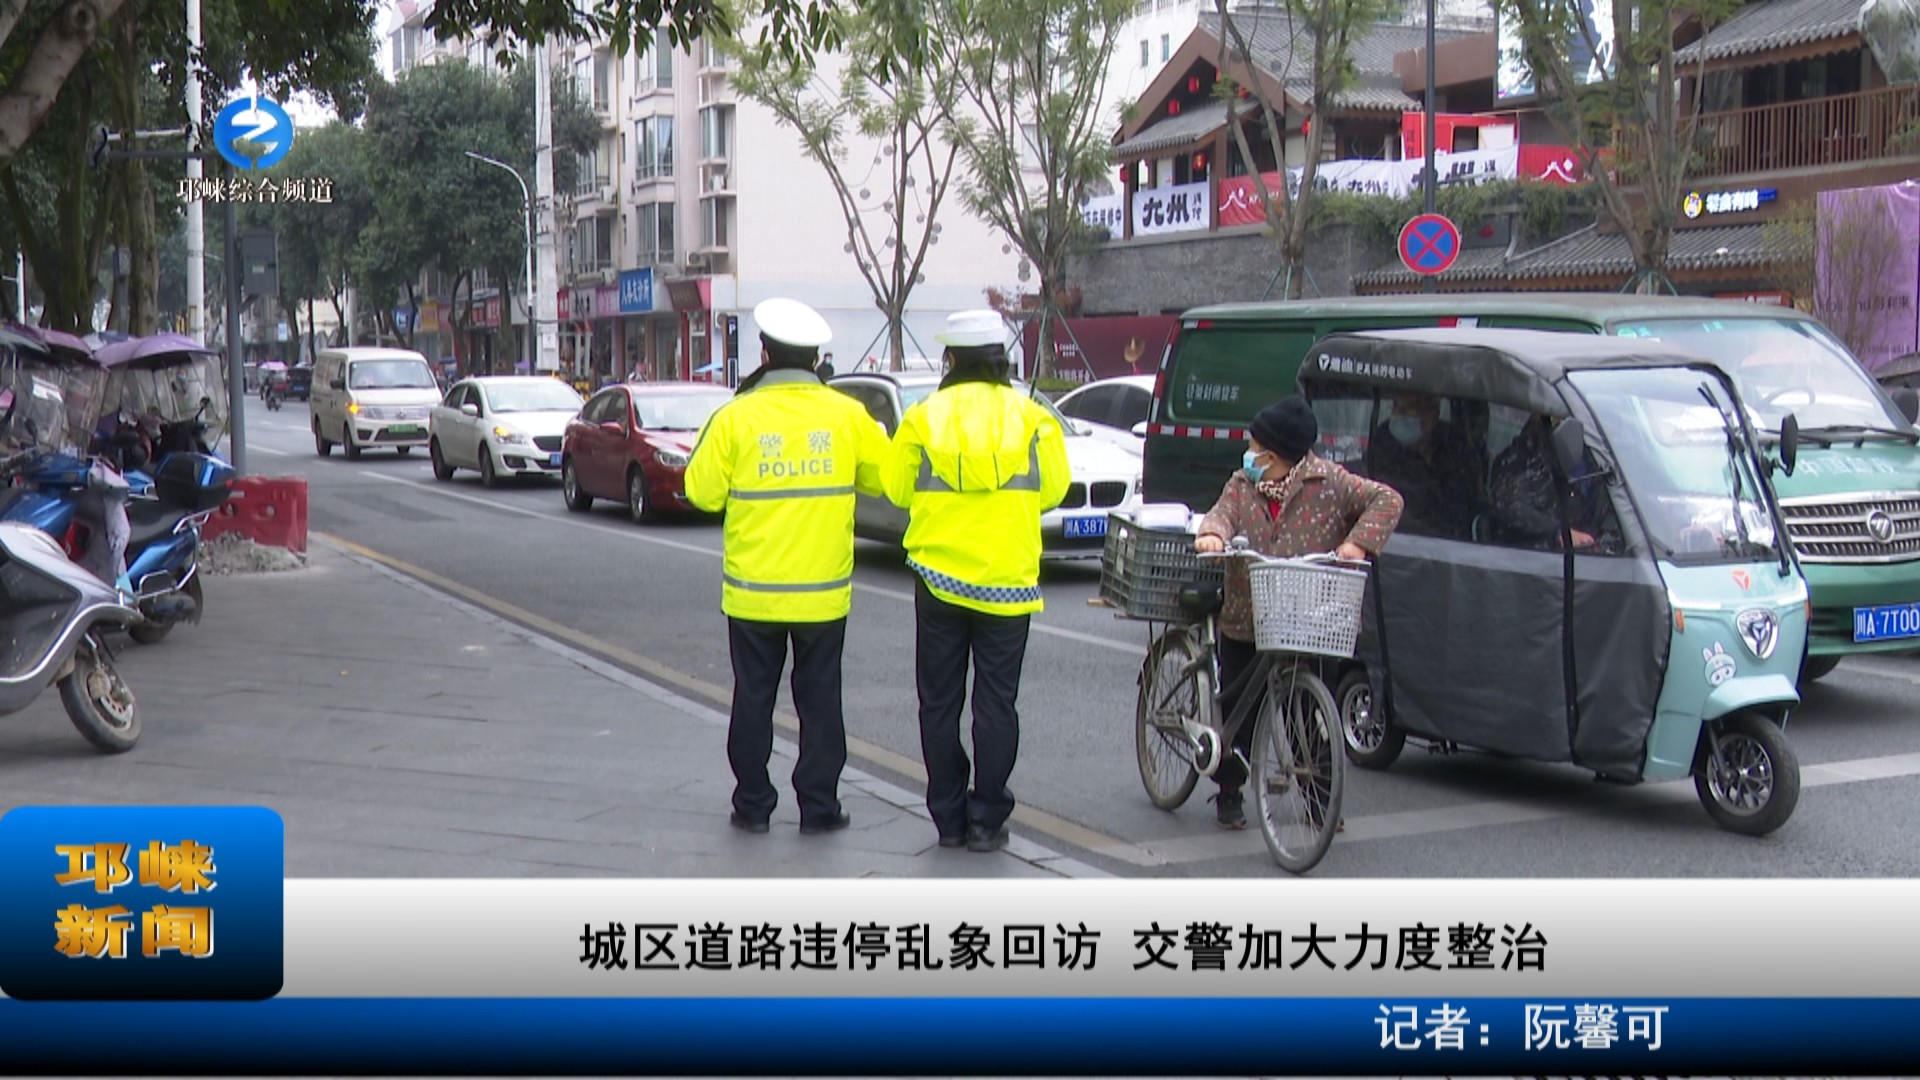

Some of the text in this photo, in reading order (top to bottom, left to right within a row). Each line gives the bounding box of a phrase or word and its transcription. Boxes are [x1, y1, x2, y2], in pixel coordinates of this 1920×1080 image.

[1142, 192, 1190, 227] 九州
[759, 431, 832, 458] 警察
[758, 458, 832, 478] POLICE
